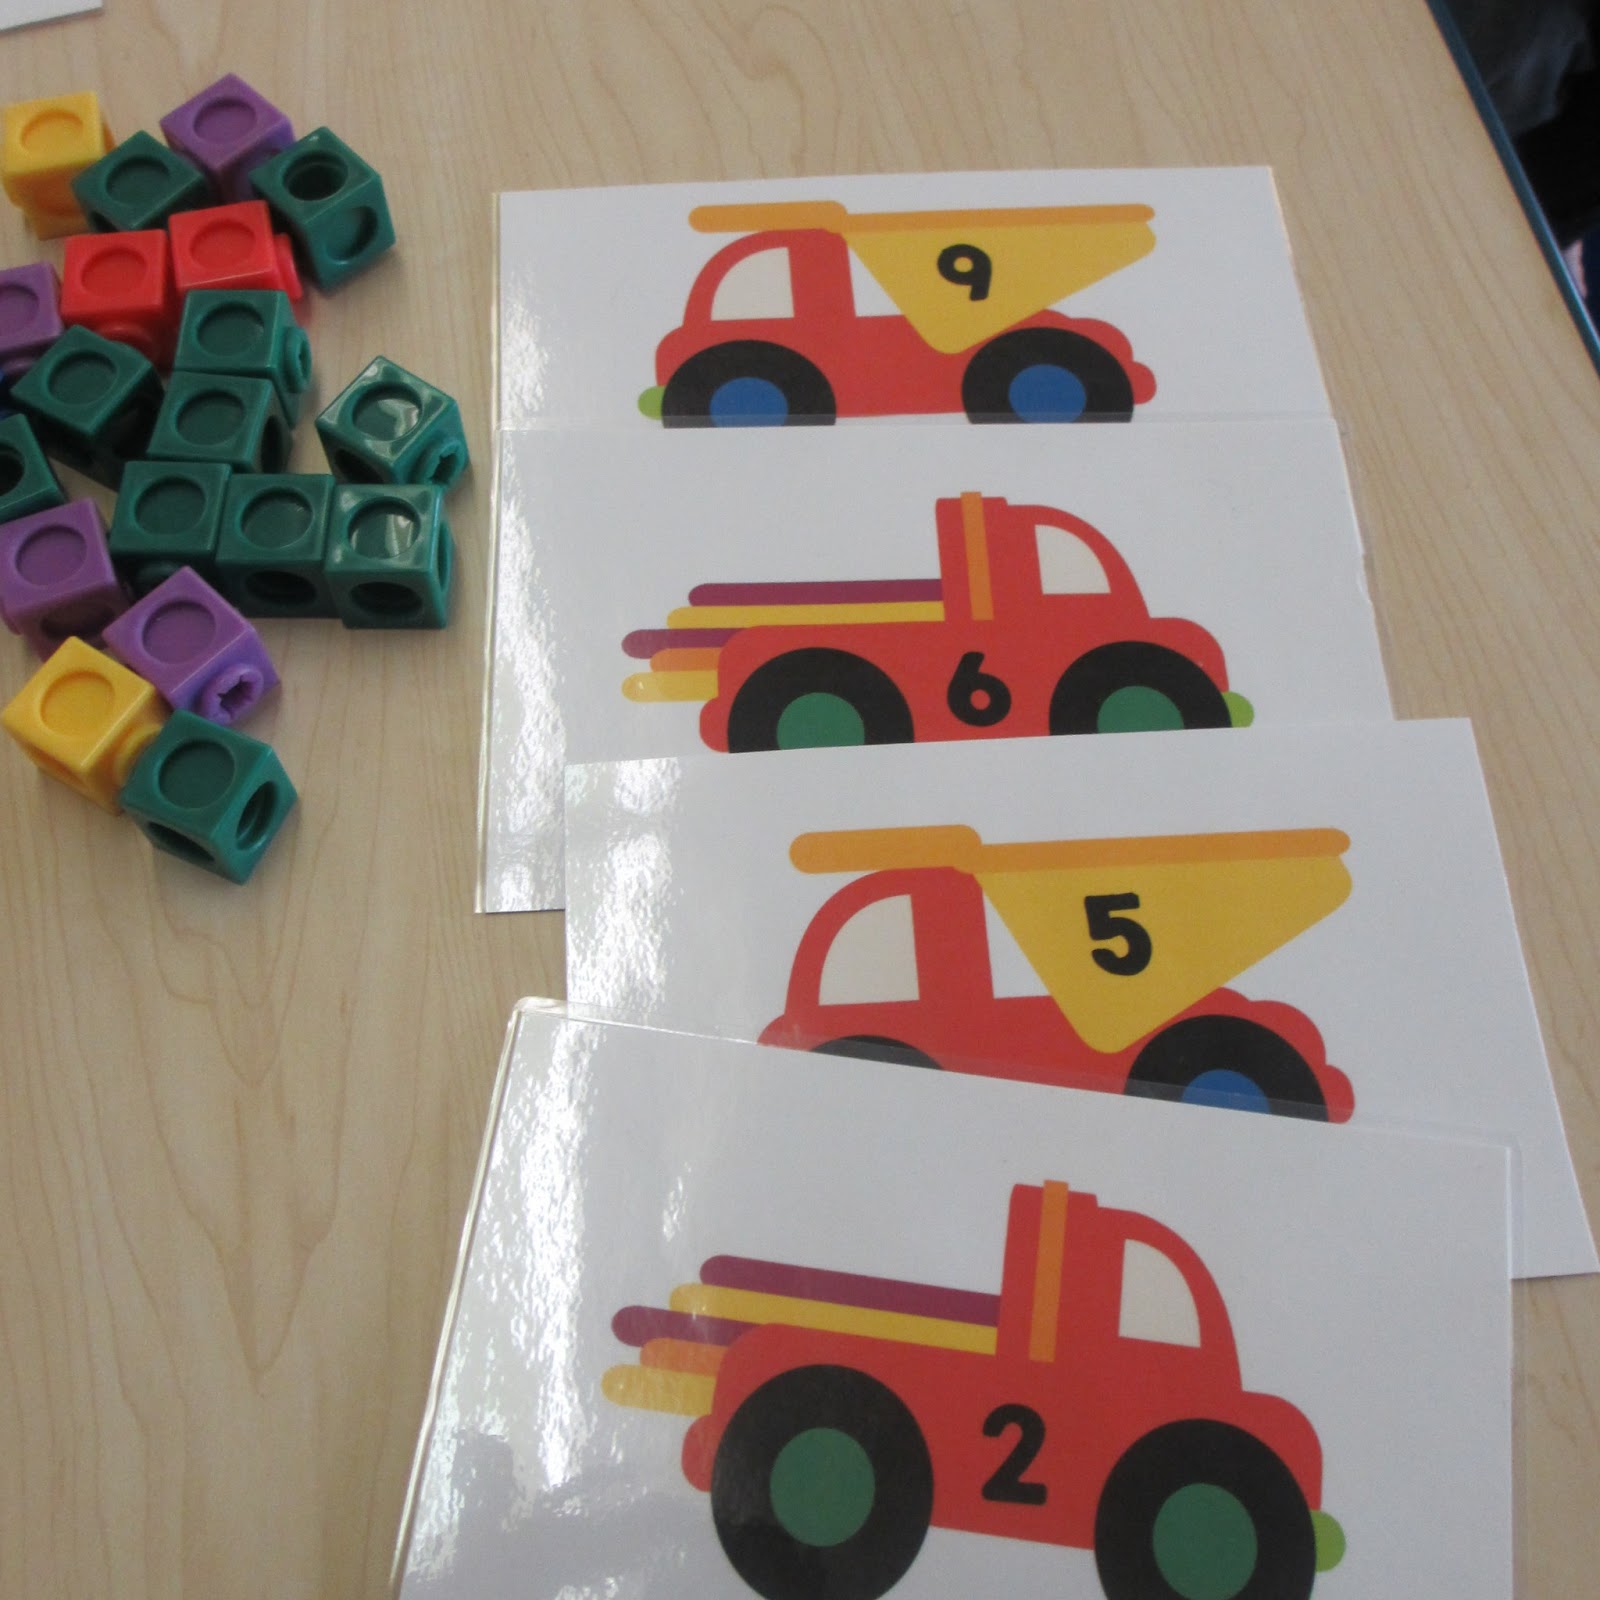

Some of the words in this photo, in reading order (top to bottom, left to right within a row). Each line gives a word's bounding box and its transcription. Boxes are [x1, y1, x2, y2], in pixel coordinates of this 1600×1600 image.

[937, 243, 993, 302] 9
[946, 651, 1012, 728] 6
[1083, 892, 1153, 977] 5
[981, 1403, 1049, 1507] 2
